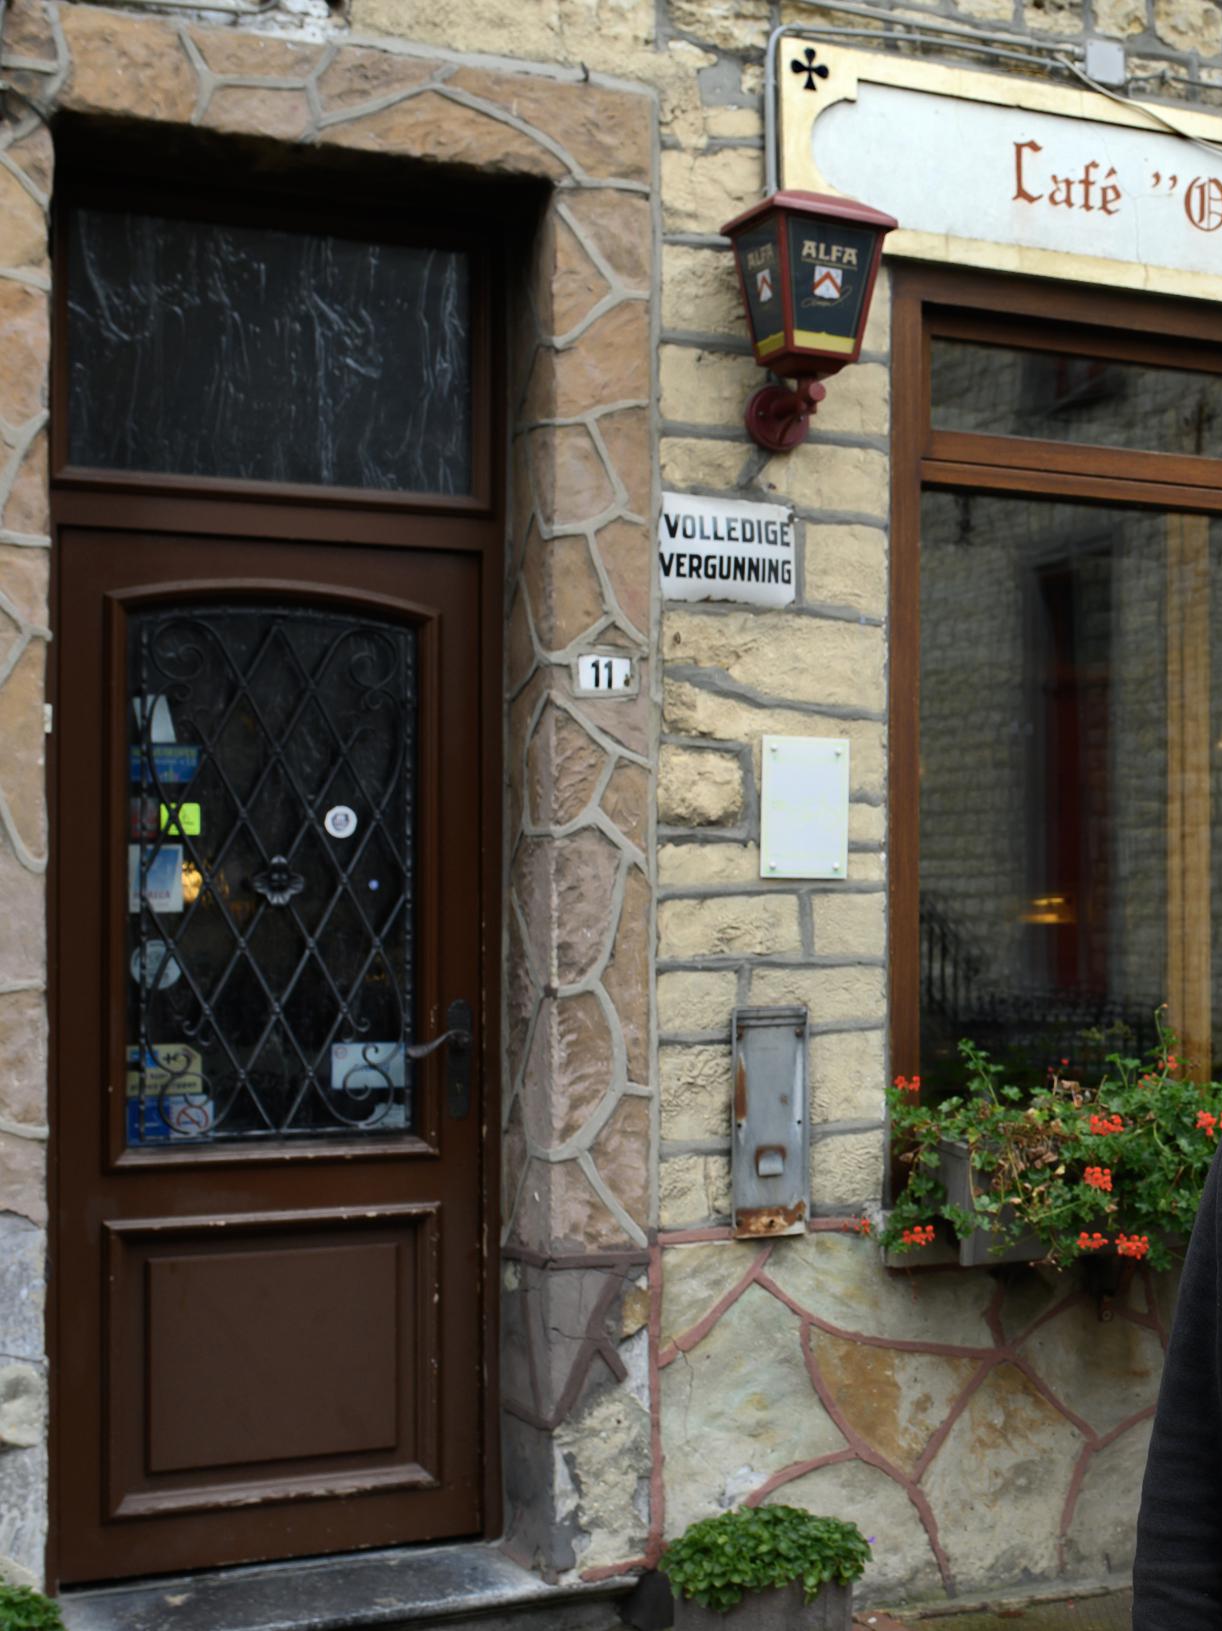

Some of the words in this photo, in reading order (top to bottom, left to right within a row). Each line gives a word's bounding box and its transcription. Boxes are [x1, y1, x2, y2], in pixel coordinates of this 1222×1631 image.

[1011, 139, 1123, 216] Café
[802, 240, 858, 265] ALFA
[663, 513, 792, 547] VOLLEDIGE
[658, 552, 792, 585] VERGUNNING
[591, 659, 613, 689] 11
